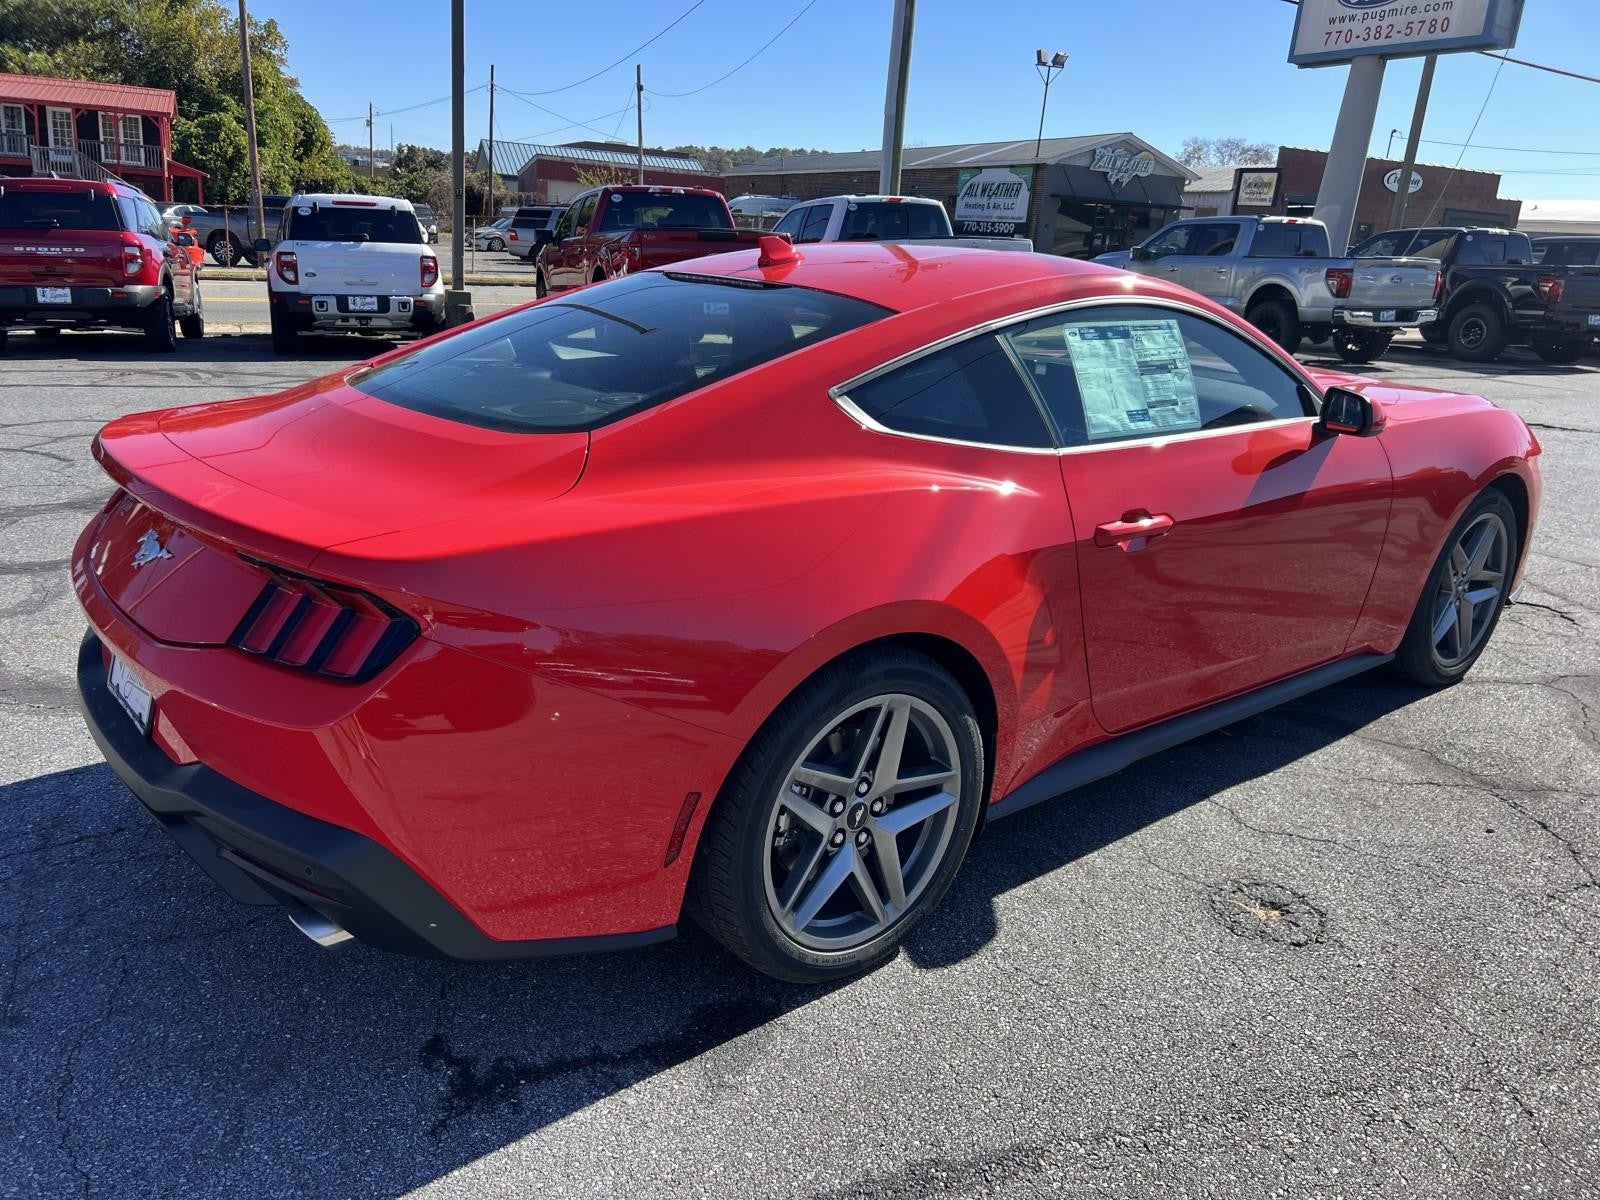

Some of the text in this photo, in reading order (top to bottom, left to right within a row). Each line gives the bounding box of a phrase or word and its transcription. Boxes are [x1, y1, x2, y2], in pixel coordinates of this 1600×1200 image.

[1328, 1, 1453, 25] www.pugmire.com
[1324, 17, 1450, 46] 770-382-5780
[1096, 155, 1152, 172] ALL WEATHER
[962, 182, 1023, 199] ALL WEATHER
[964, 202, 985, 211] Heating
[963, 221, 1015, 233] 770-315-5909
